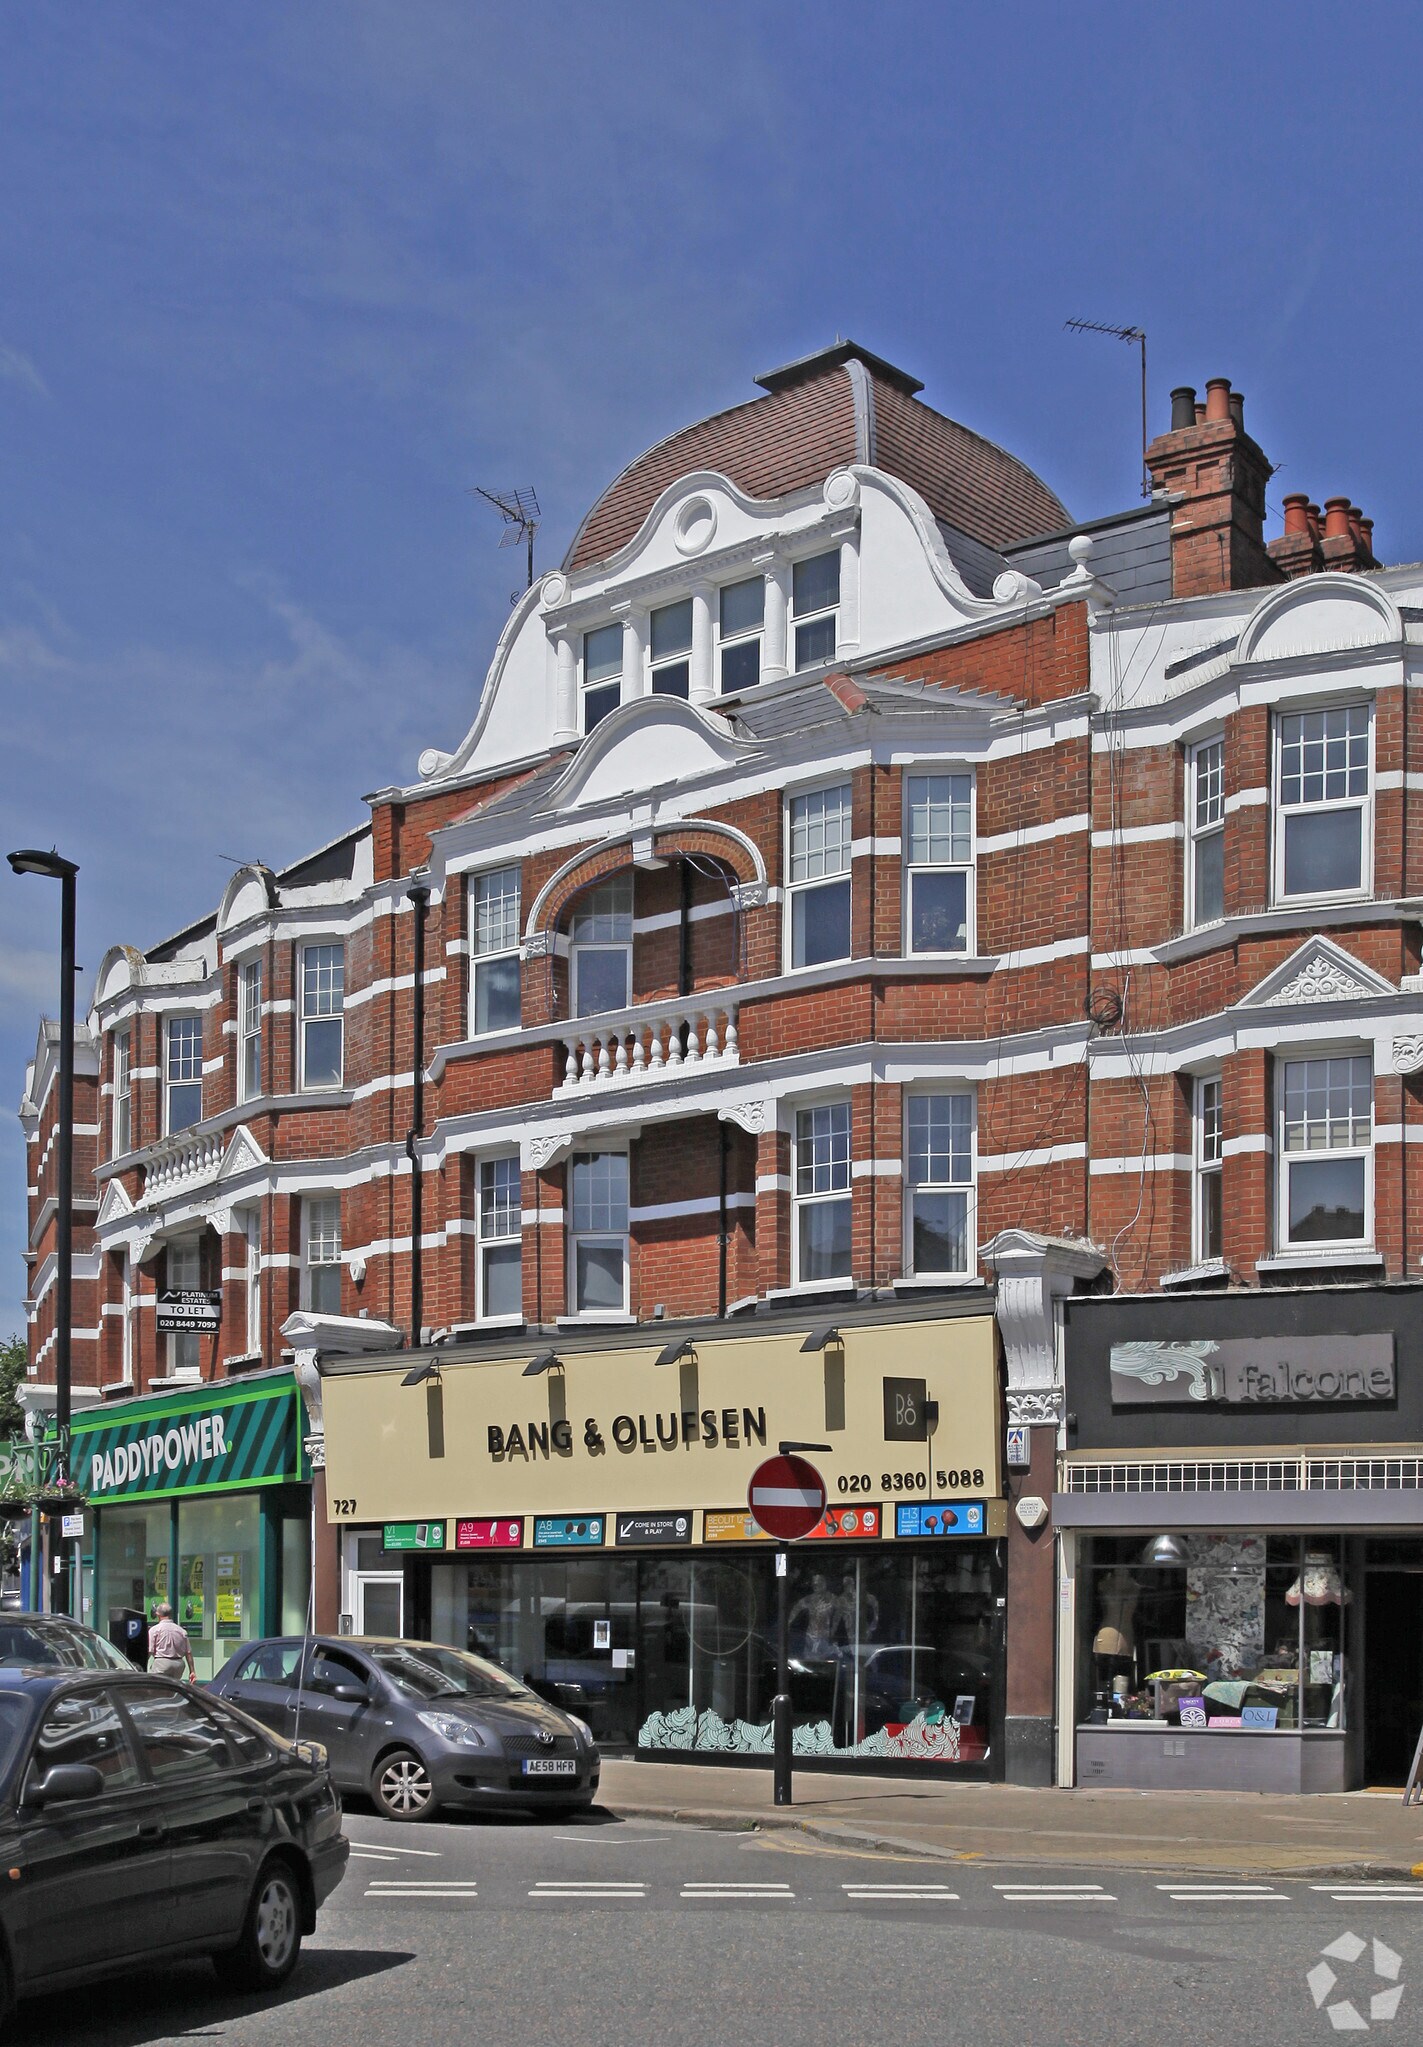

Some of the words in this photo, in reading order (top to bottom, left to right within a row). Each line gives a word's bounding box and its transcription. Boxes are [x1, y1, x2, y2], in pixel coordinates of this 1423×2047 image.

[170, 1306, 185, 1314] TO
[188, 1306, 206, 1315] LET
[197, 1321, 217, 1329] 7099
[1239, 1361, 1394, 1401] falcone
[487, 1420, 572, 1454] BANG
[583, 1418, 602, 1448] &
[611, 1406, 764, 1446] OLUFSEN
[837, 1474, 871, 1494] 020
[881, 1471, 927, 1491] 8360
[936, 1468, 985, 1489] 5088
[333, 1499, 357, 1516] 727
[901, 1508, 918, 1520] H3
[460, 1522, 474, 1533] A9
[538, 1520, 553, 1531] A8
[129, 1621, 138, 1635] P
[1243, 1710, 1274, 1722] O&L
[529, 1761, 555, 1772] AE58
[556, 1761, 574, 1772] HFR
